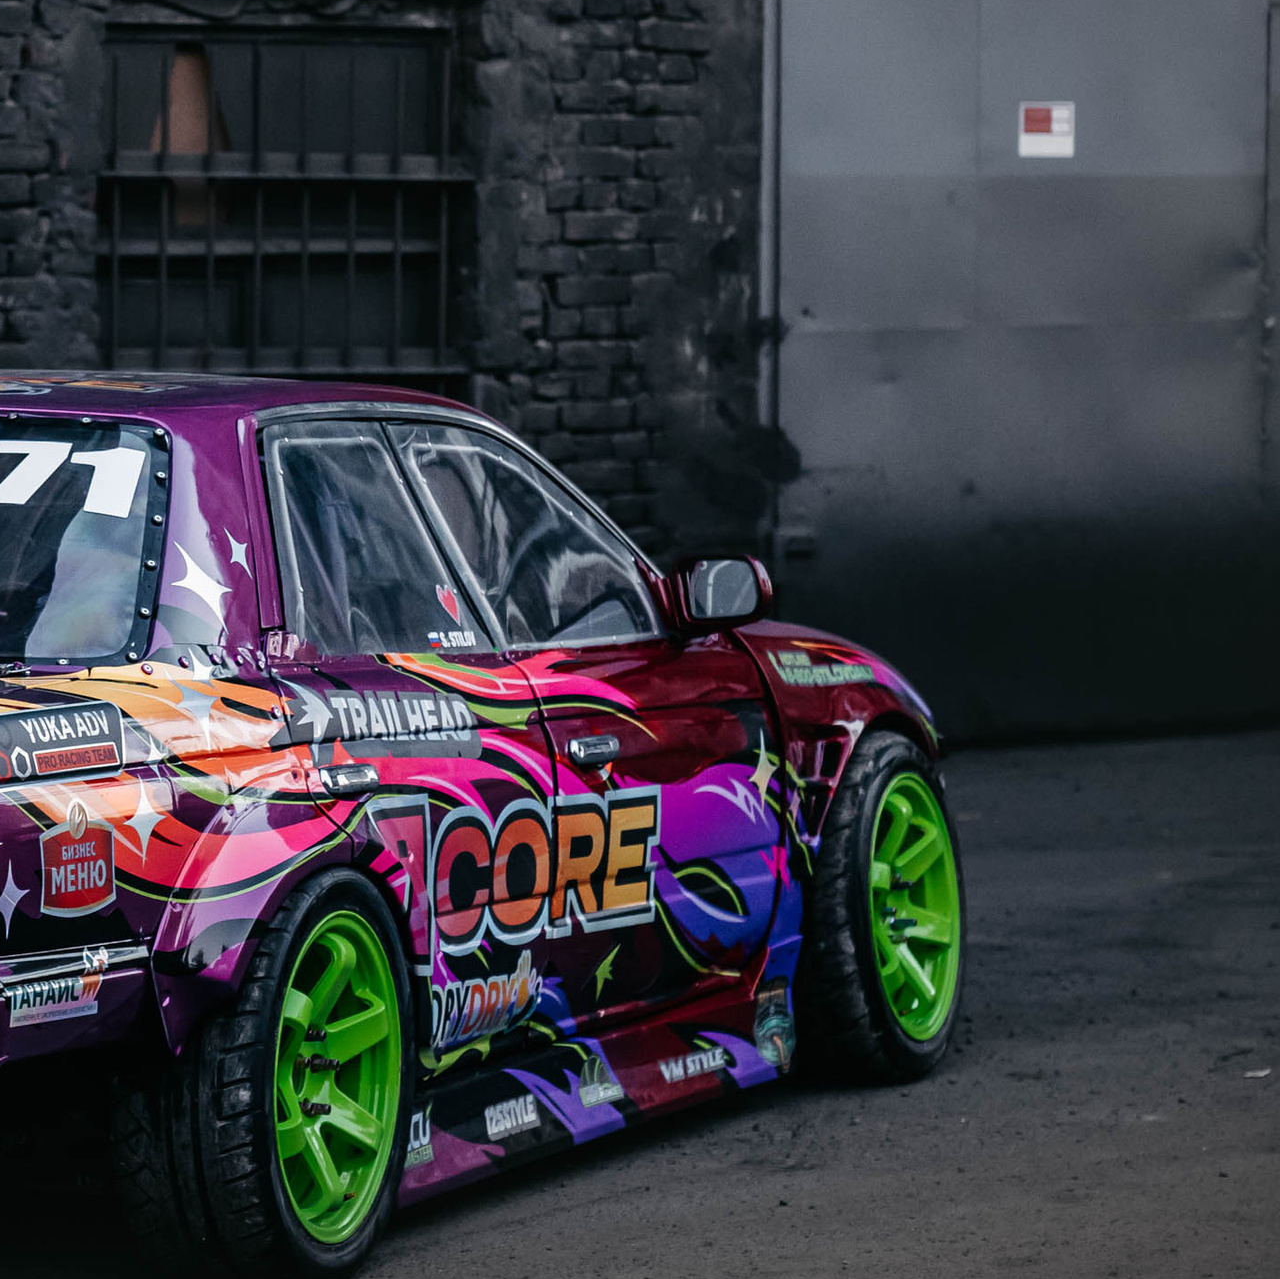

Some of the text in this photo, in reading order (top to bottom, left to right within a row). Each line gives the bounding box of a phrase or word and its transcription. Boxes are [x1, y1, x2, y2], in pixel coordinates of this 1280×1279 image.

[19, 709, 110, 744] YUKA ADV
[329, 696, 473, 742] TRAILHEAD
[58, 750, 91, 768] RACING
[92, 747, 117, 763] TEAM
[61, 841, 97, 861] БИЗНЕС
[51, 858, 108, 896] МЕНЮ
[684, 1047, 726, 1077] STYLE
